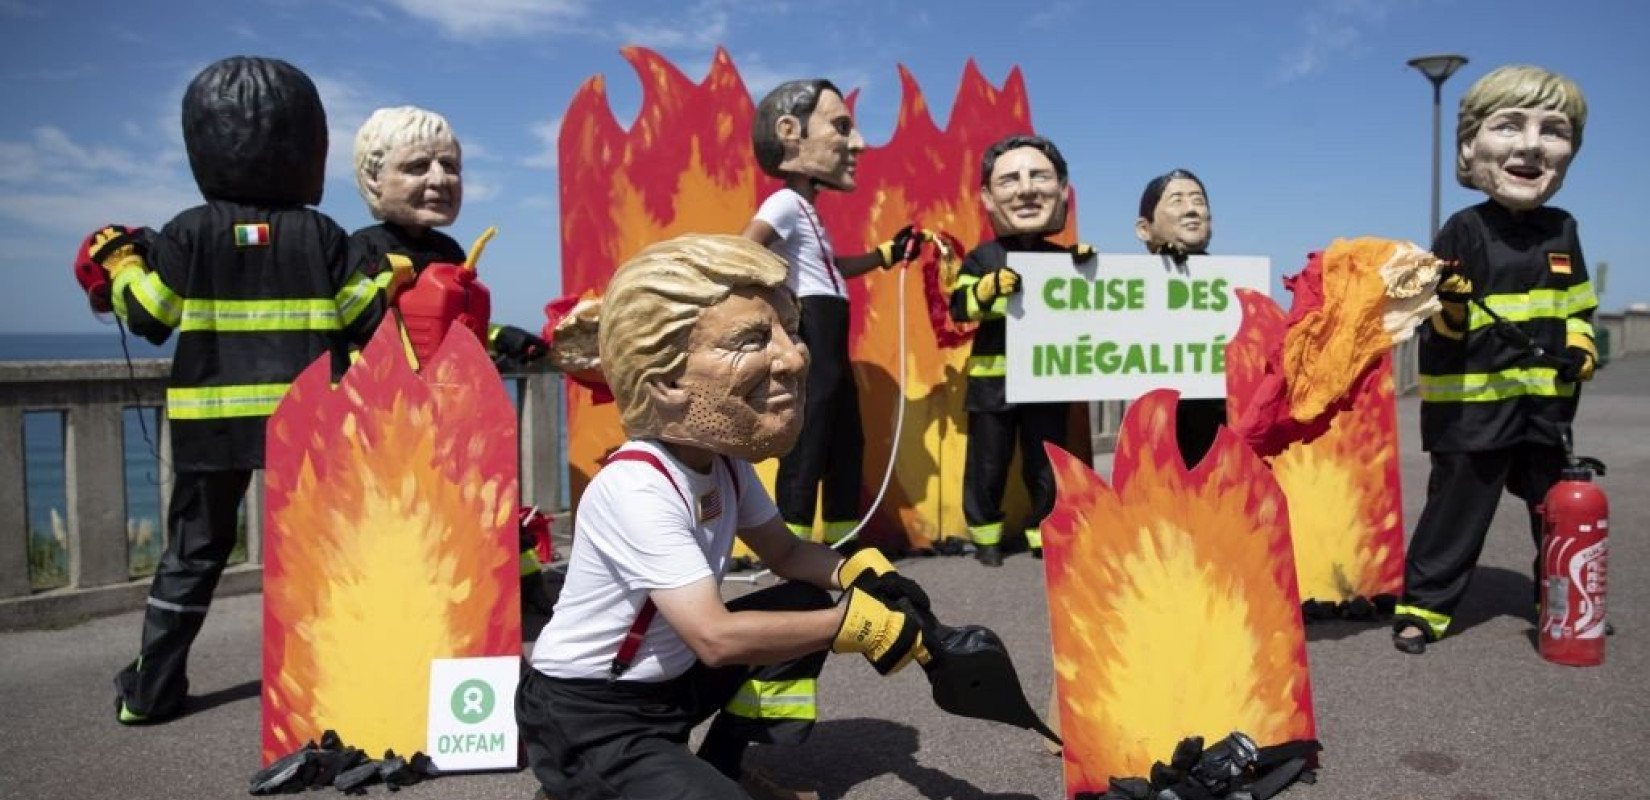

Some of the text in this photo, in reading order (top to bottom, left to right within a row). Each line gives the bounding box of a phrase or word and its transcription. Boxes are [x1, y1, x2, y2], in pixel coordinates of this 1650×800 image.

[1041, 277, 1230, 312] CRISE DES
[1032, 334, 1226, 377] INÉGALITÉ
[437, 732, 505, 755] OXFAM
